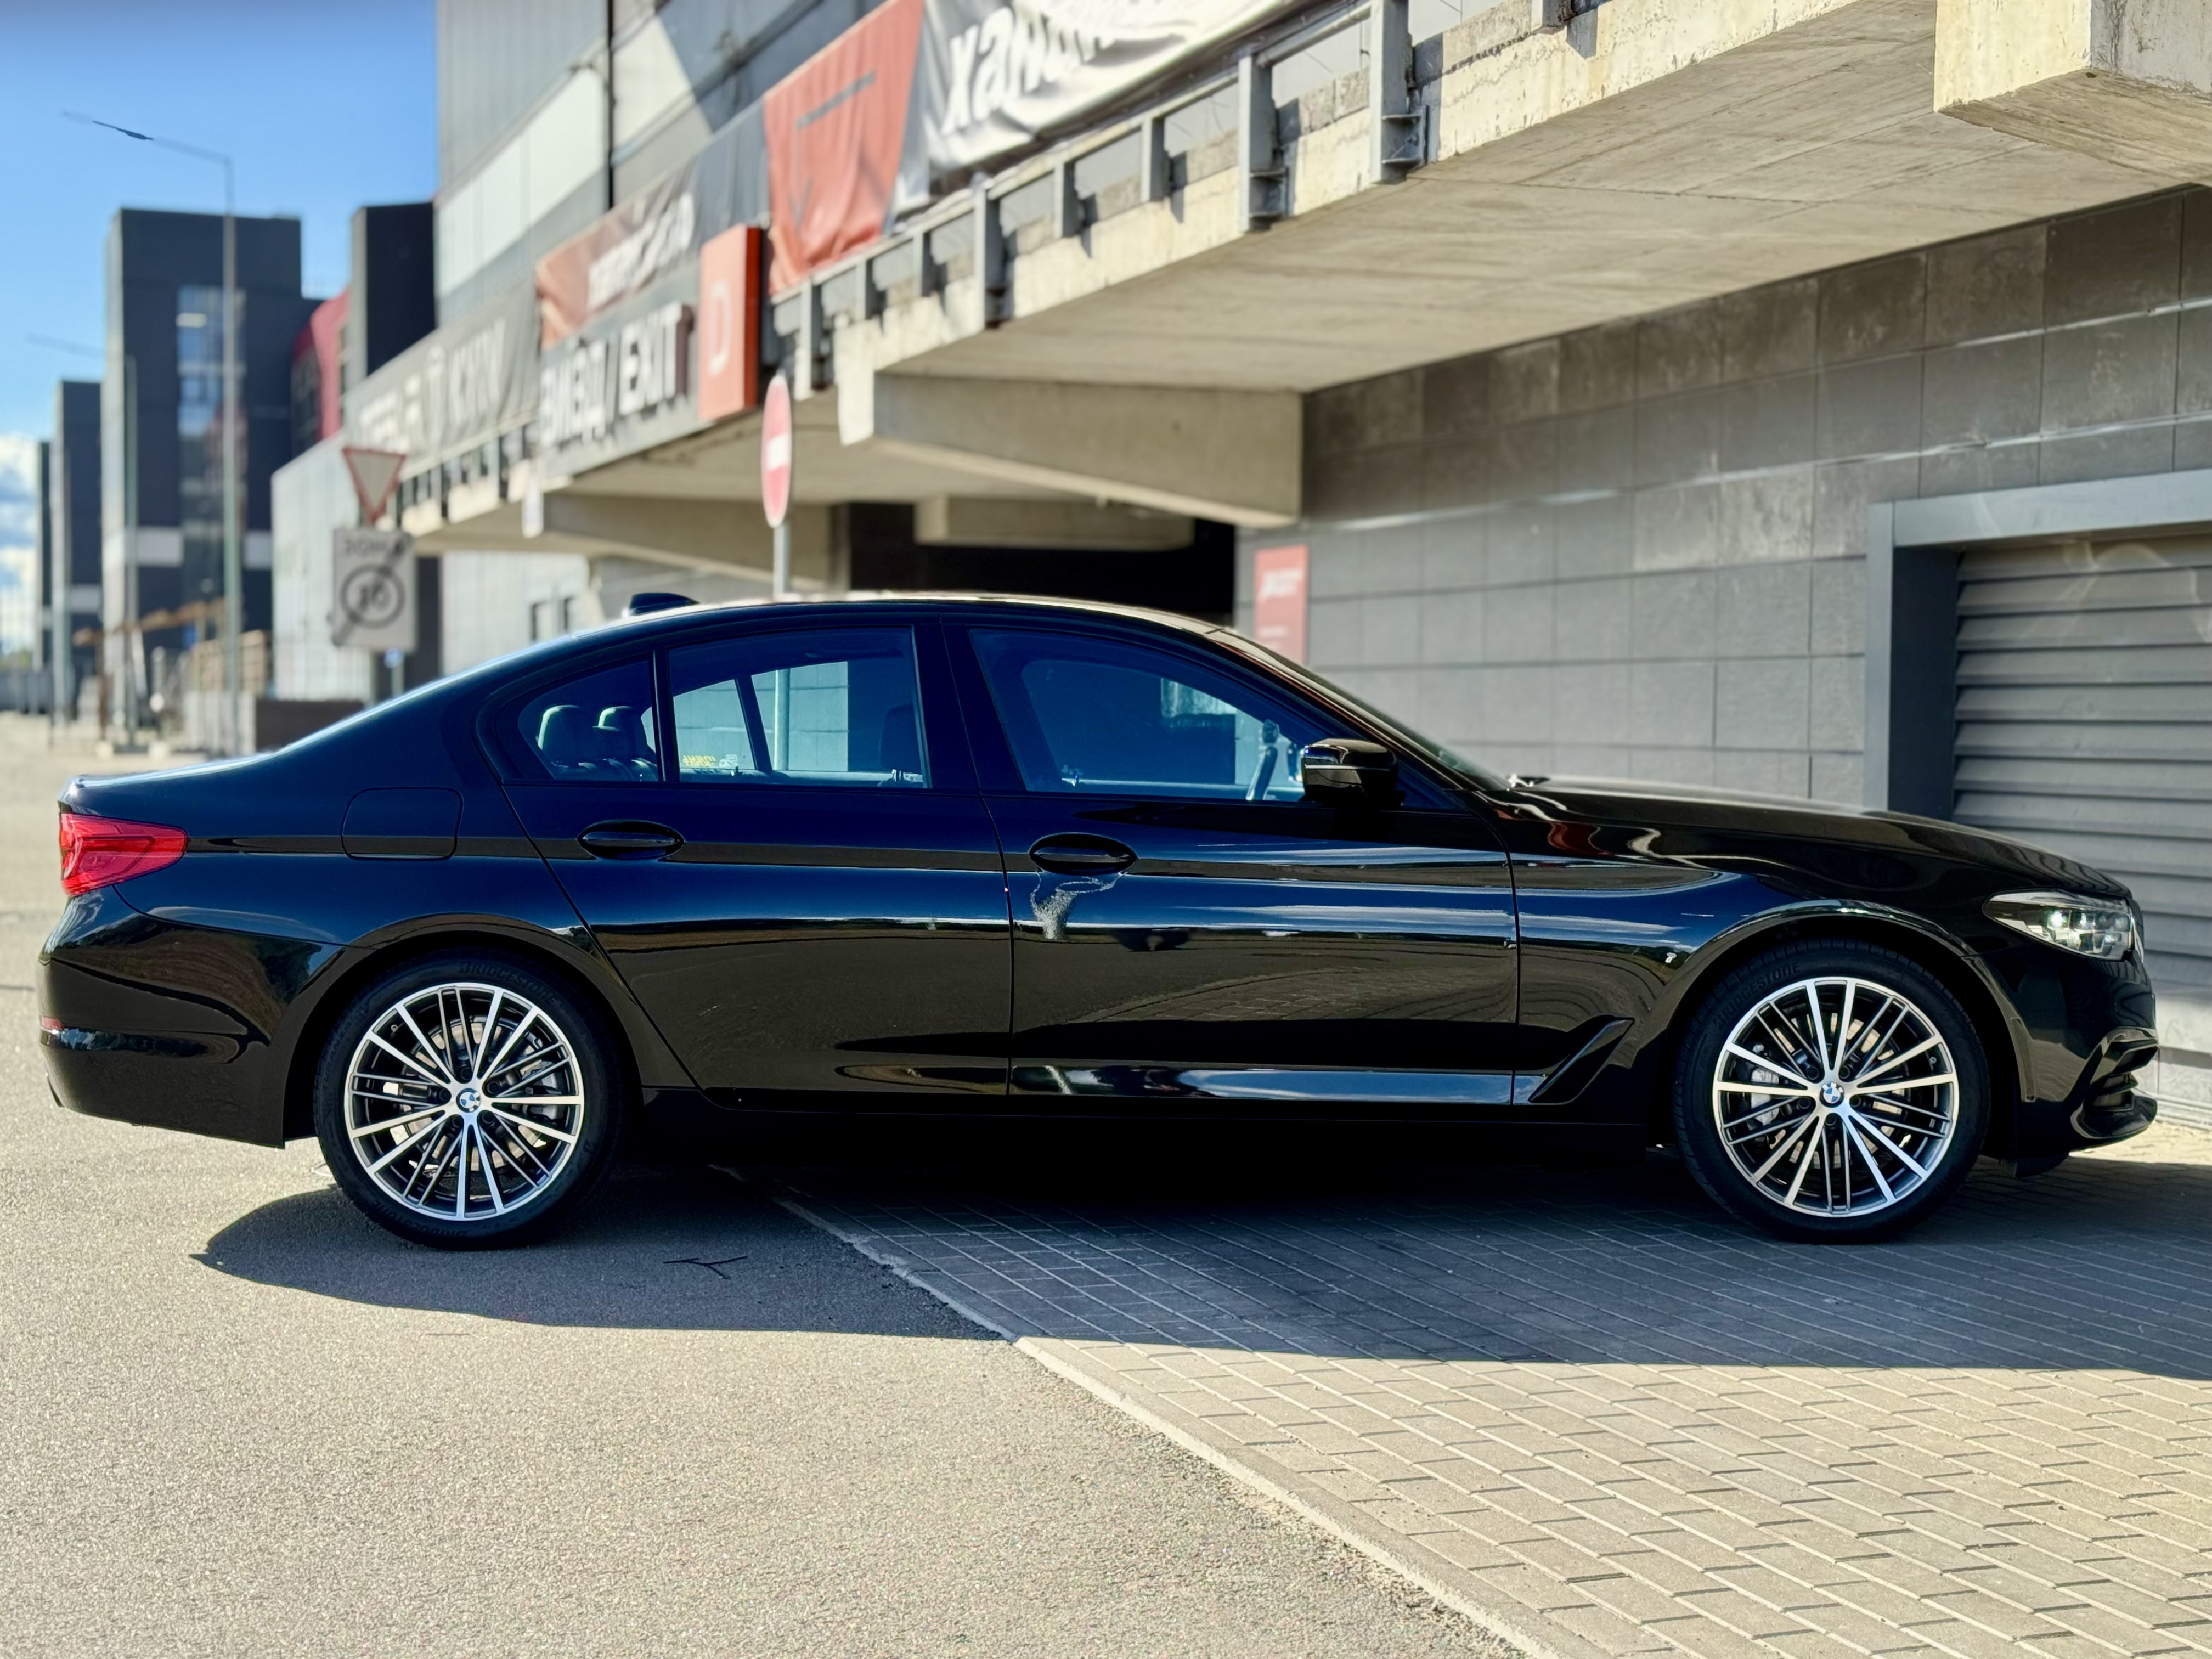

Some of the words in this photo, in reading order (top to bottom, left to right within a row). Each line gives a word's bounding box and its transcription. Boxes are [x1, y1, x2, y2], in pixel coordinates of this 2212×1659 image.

[619, 300, 682, 416] EXIT
[459, 962, 557, 1005] BRIDGESTONE
[1712, 963, 1801, 1026] BRIDGESTONE
